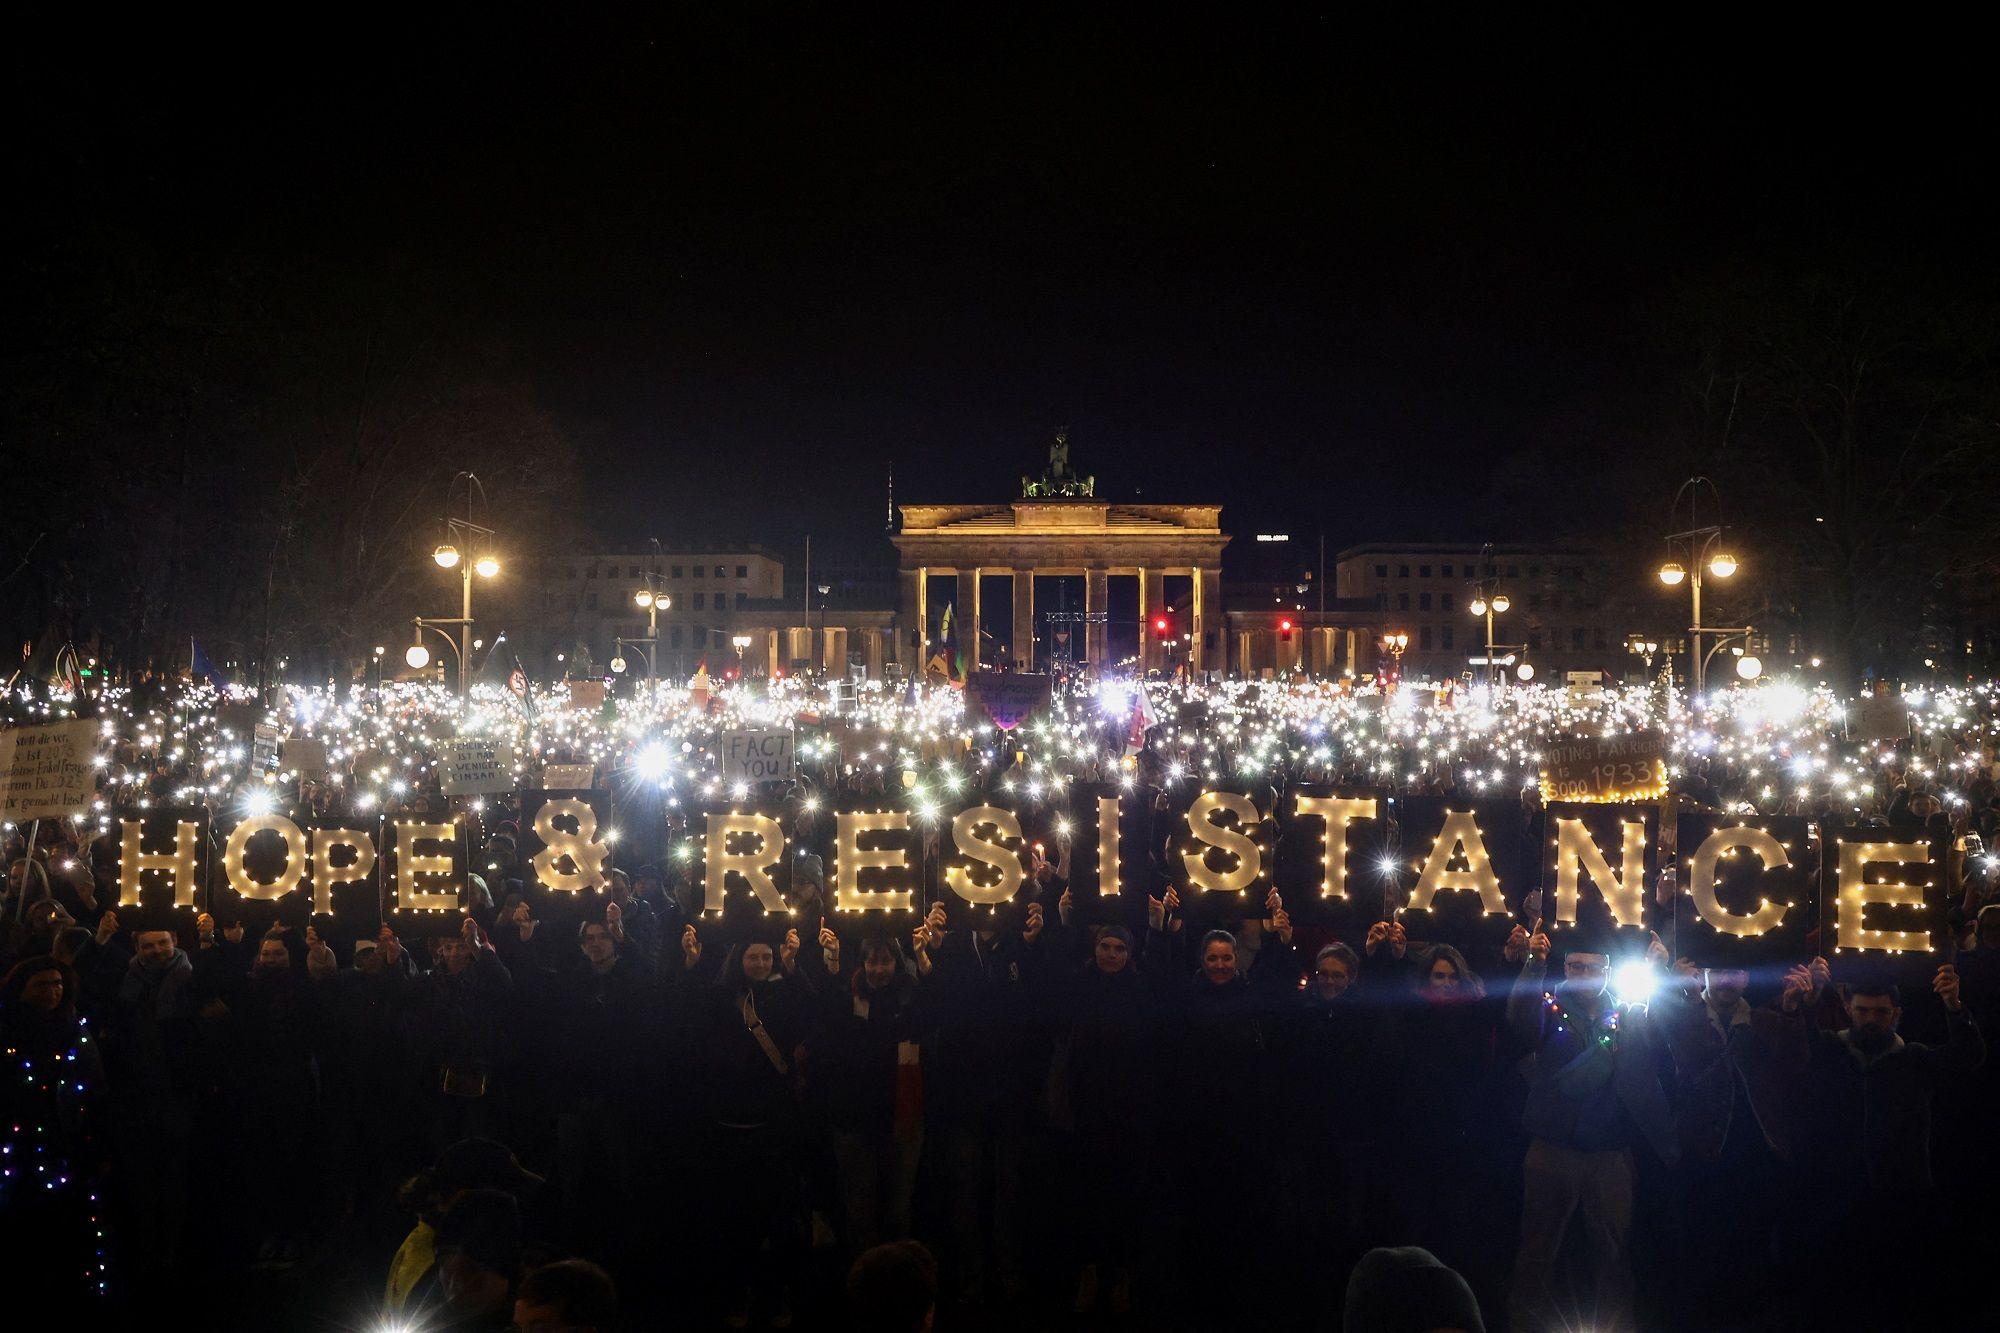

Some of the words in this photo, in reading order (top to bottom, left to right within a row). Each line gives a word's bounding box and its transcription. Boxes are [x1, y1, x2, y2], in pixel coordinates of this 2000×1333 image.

[731, 735, 789, 759] FACT
[1591, 761, 1652, 789] 1933
[116, 811, 464, 917] HOPE
[532, 797, 610, 895] &
